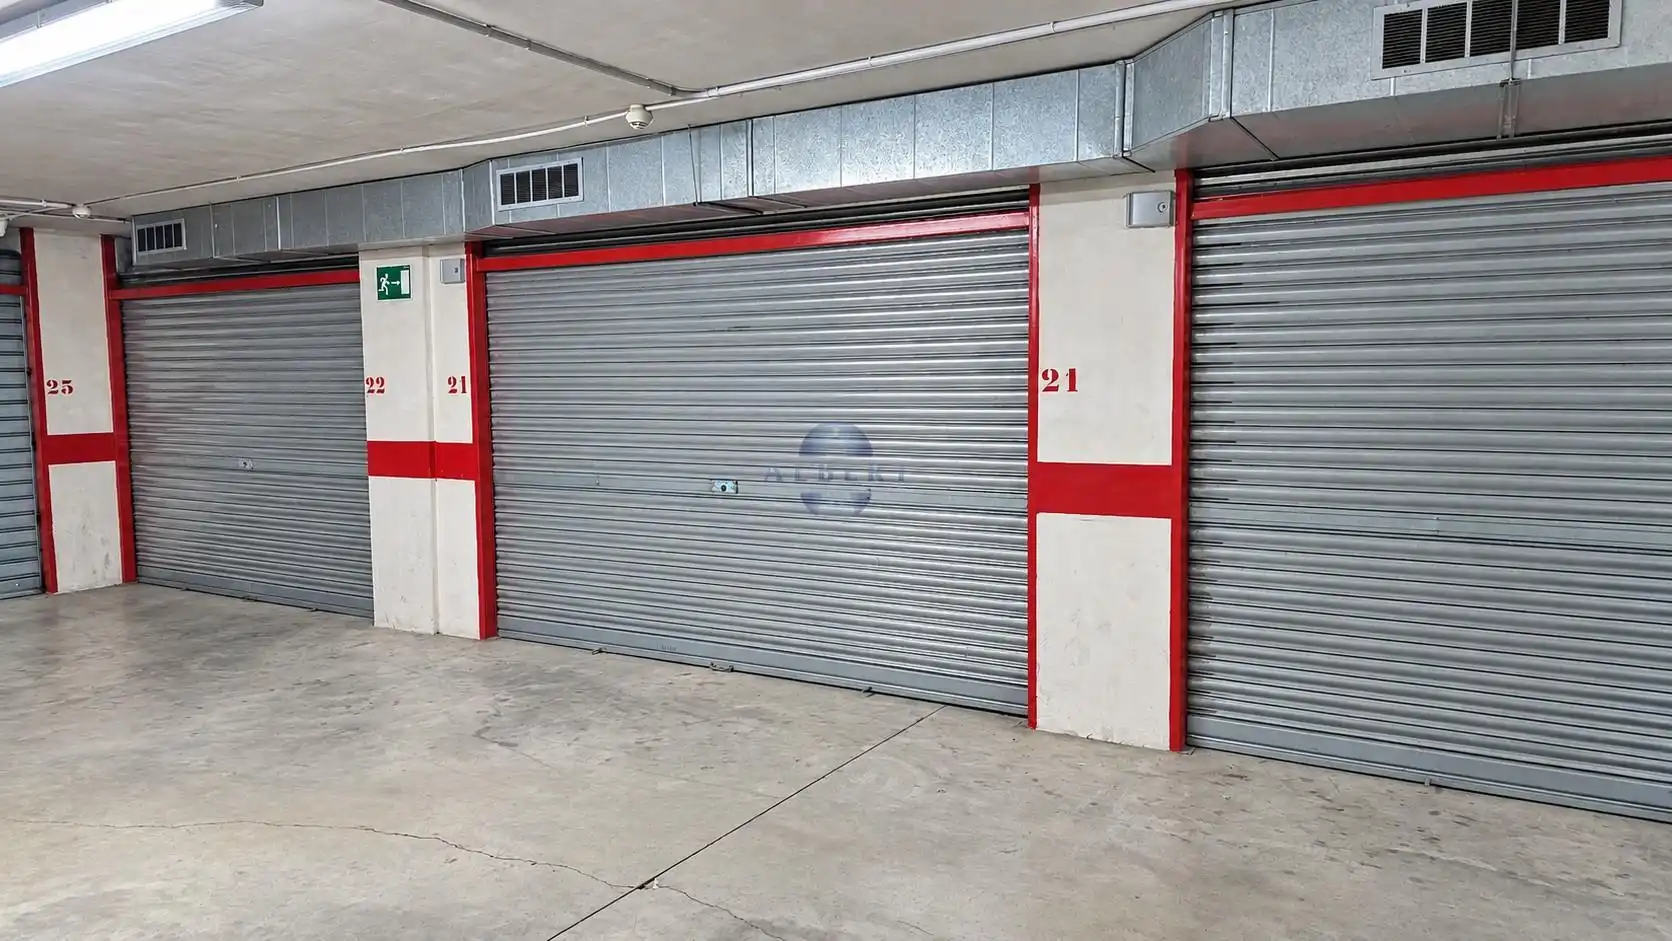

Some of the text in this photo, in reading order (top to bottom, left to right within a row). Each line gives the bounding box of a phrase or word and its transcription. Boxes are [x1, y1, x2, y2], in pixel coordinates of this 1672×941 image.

[46, 379, 74, 395] 25
[365, 376, 385, 394] 22
[447, 375, 467, 394] 21
[1041, 367, 1079, 392] 21
